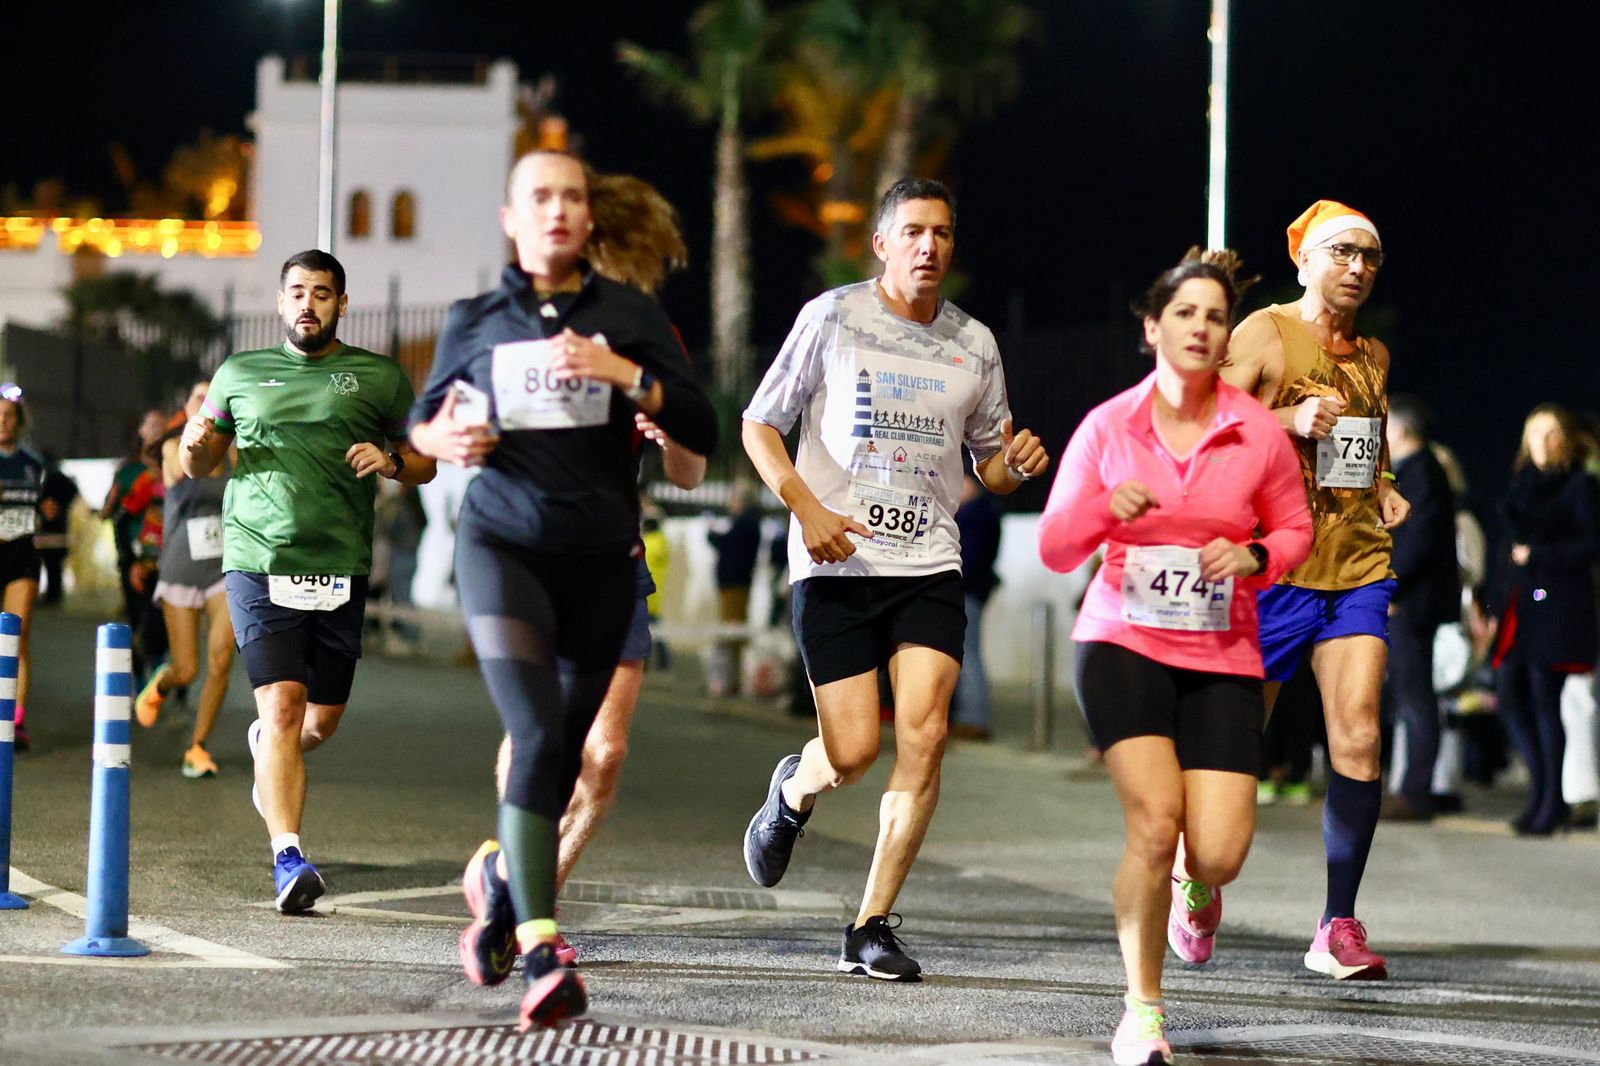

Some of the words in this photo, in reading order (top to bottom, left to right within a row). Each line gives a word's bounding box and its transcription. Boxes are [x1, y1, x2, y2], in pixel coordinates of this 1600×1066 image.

[875, 371, 896, 386] SAN
[897, 373, 946, 393] SILVESTRE
[874, 430, 890, 440] REAL
[890, 432, 906, 441] CLUB
[1340, 437, 1374, 461] 739
[868, 504, 916, 534] 938
[868, 537, 898, 548] mayoral
[1150, 569, 1209, 598] 474
